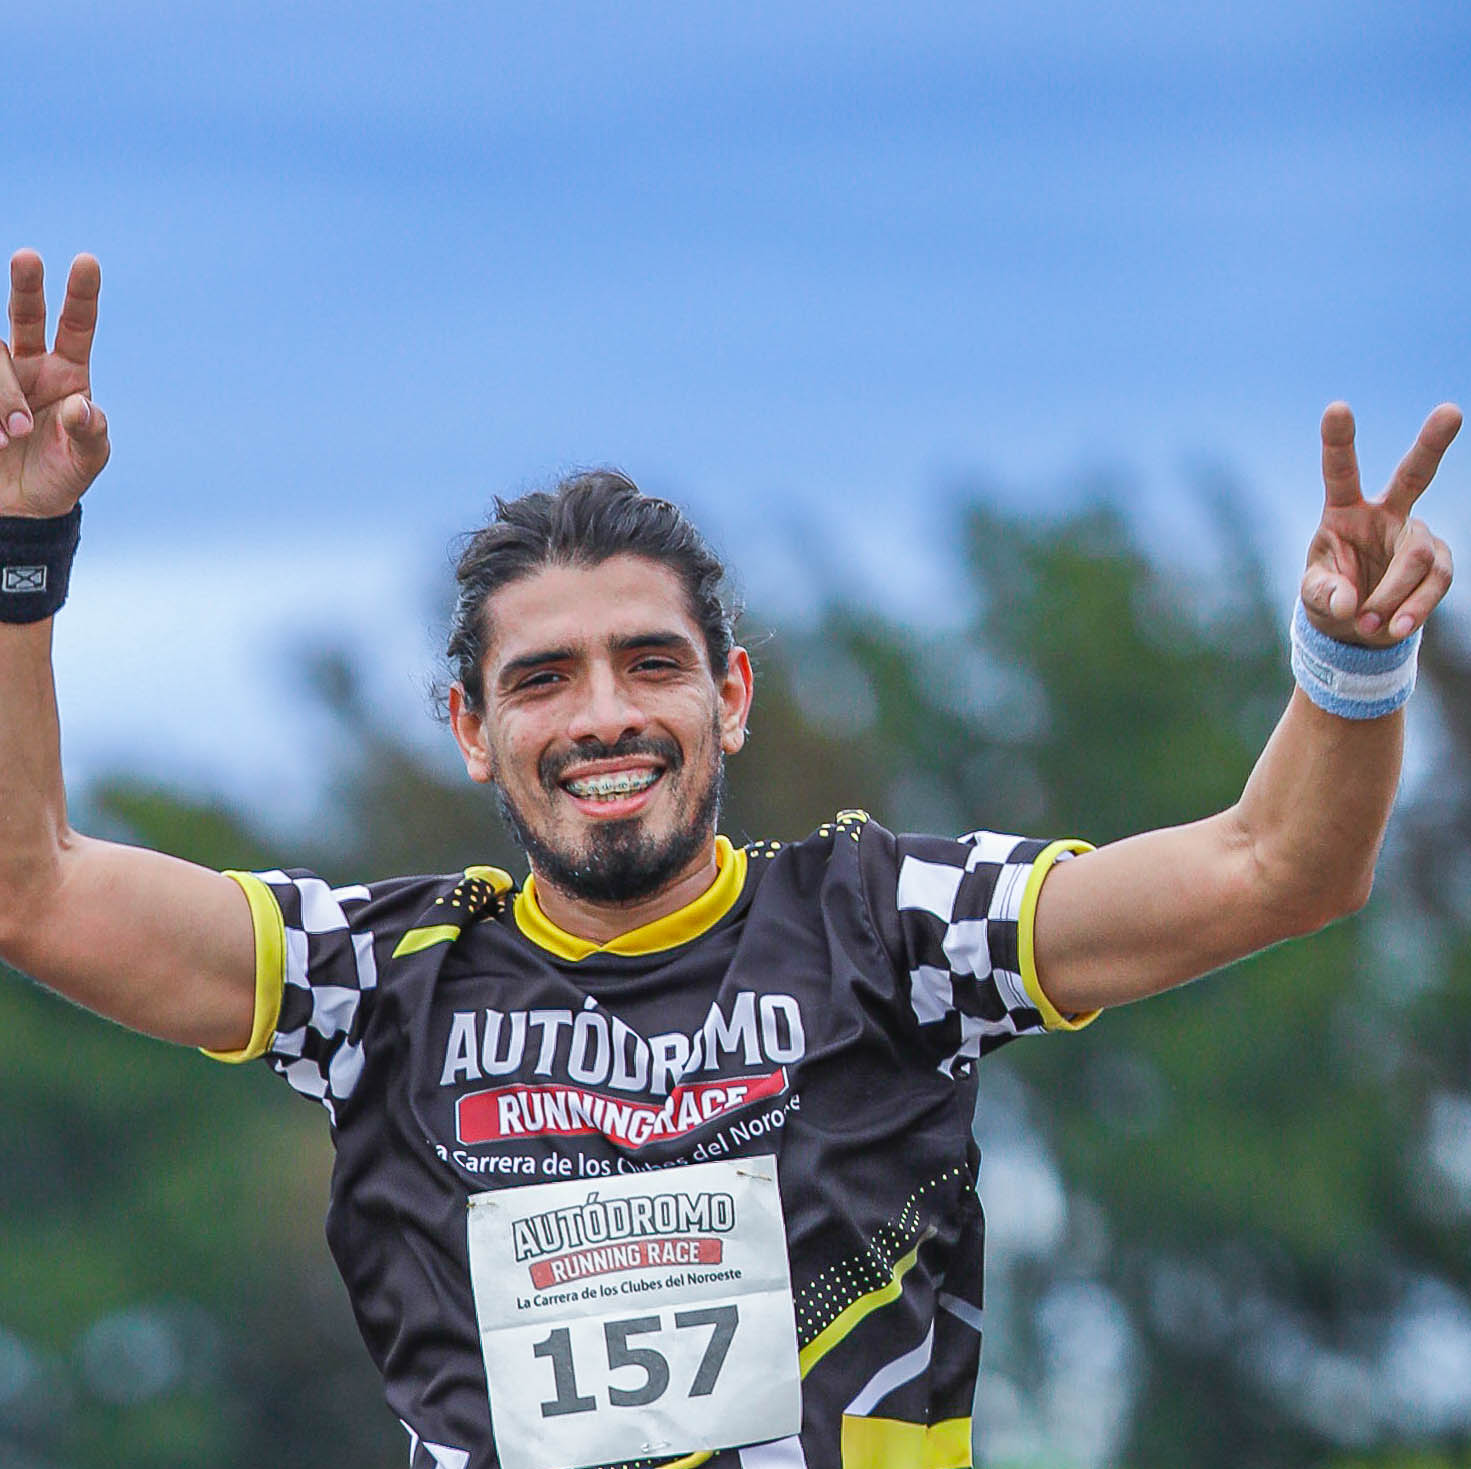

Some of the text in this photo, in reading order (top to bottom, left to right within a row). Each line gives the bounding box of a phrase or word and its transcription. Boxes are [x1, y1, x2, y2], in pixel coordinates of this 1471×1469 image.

[497, 1091, 654, 1145] RUNNING
[542, 1152, 572, 1176] de
[578, 1152, 611, 1177] los
[693, 1132, 729, 1162] del
[512, 1192, 735, 1262] AUTÓDROMO
[551, 1241, 700, 1283] RUNNING RACE
[517, 1268, 742, 1310] La Carrera de los Clubes del Noroeste
[532, 1304, 739, 1419] 157
